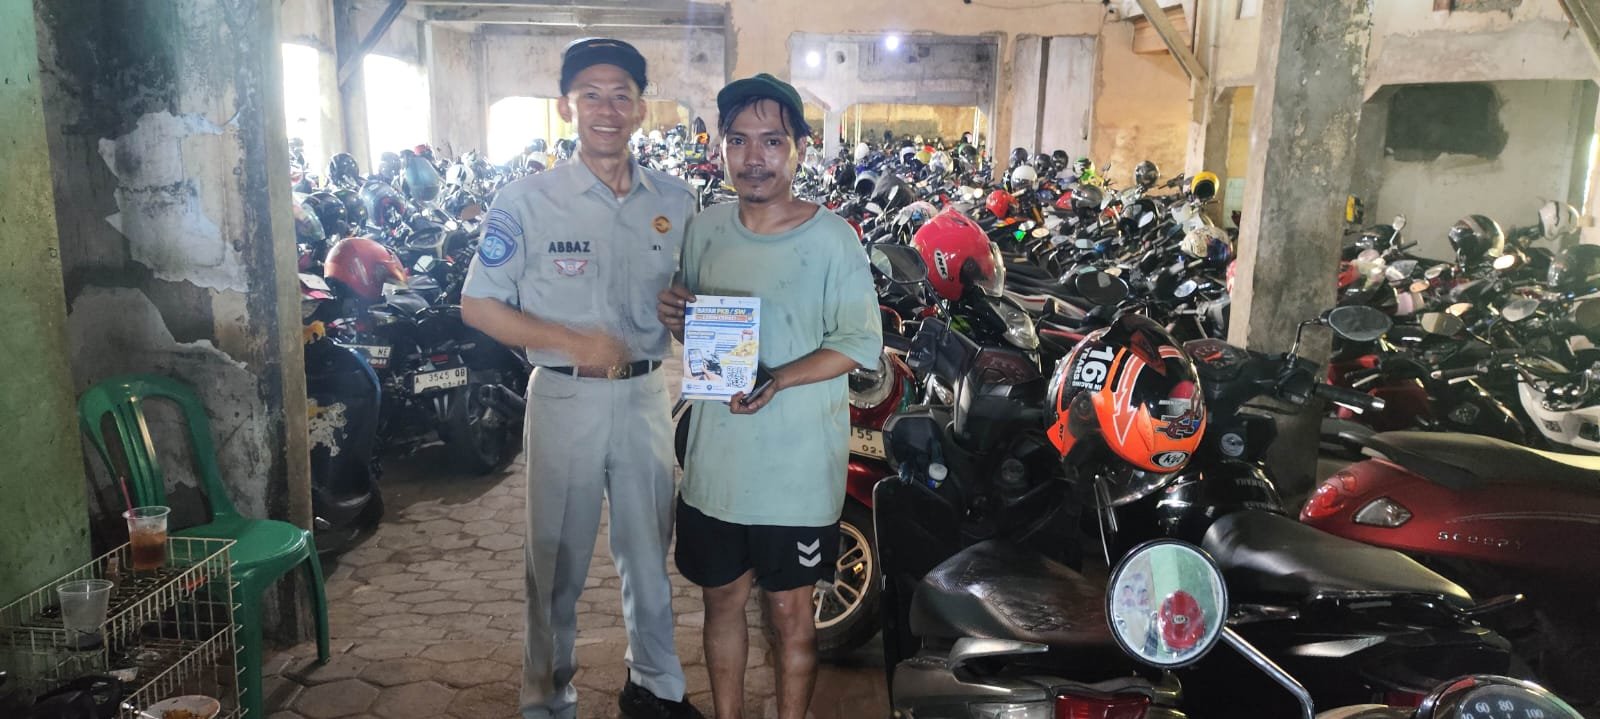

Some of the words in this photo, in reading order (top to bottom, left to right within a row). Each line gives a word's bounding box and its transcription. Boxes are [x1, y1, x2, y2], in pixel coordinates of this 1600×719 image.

[548, 241, 591, 253] ABBAZ
[936, 252, 947, 276] INK
[1073, 346, 1093, 380] YEARS
[1081, 346, 1114, 384] 16
[1072, 381, 1094, 390] RACING
[1094, 383, 1102, 391] IN
[1475, 702, 1490, 713] 60
[1498, 701, 1514, 712] 80
[1524, 708, 1544, 719] 100
